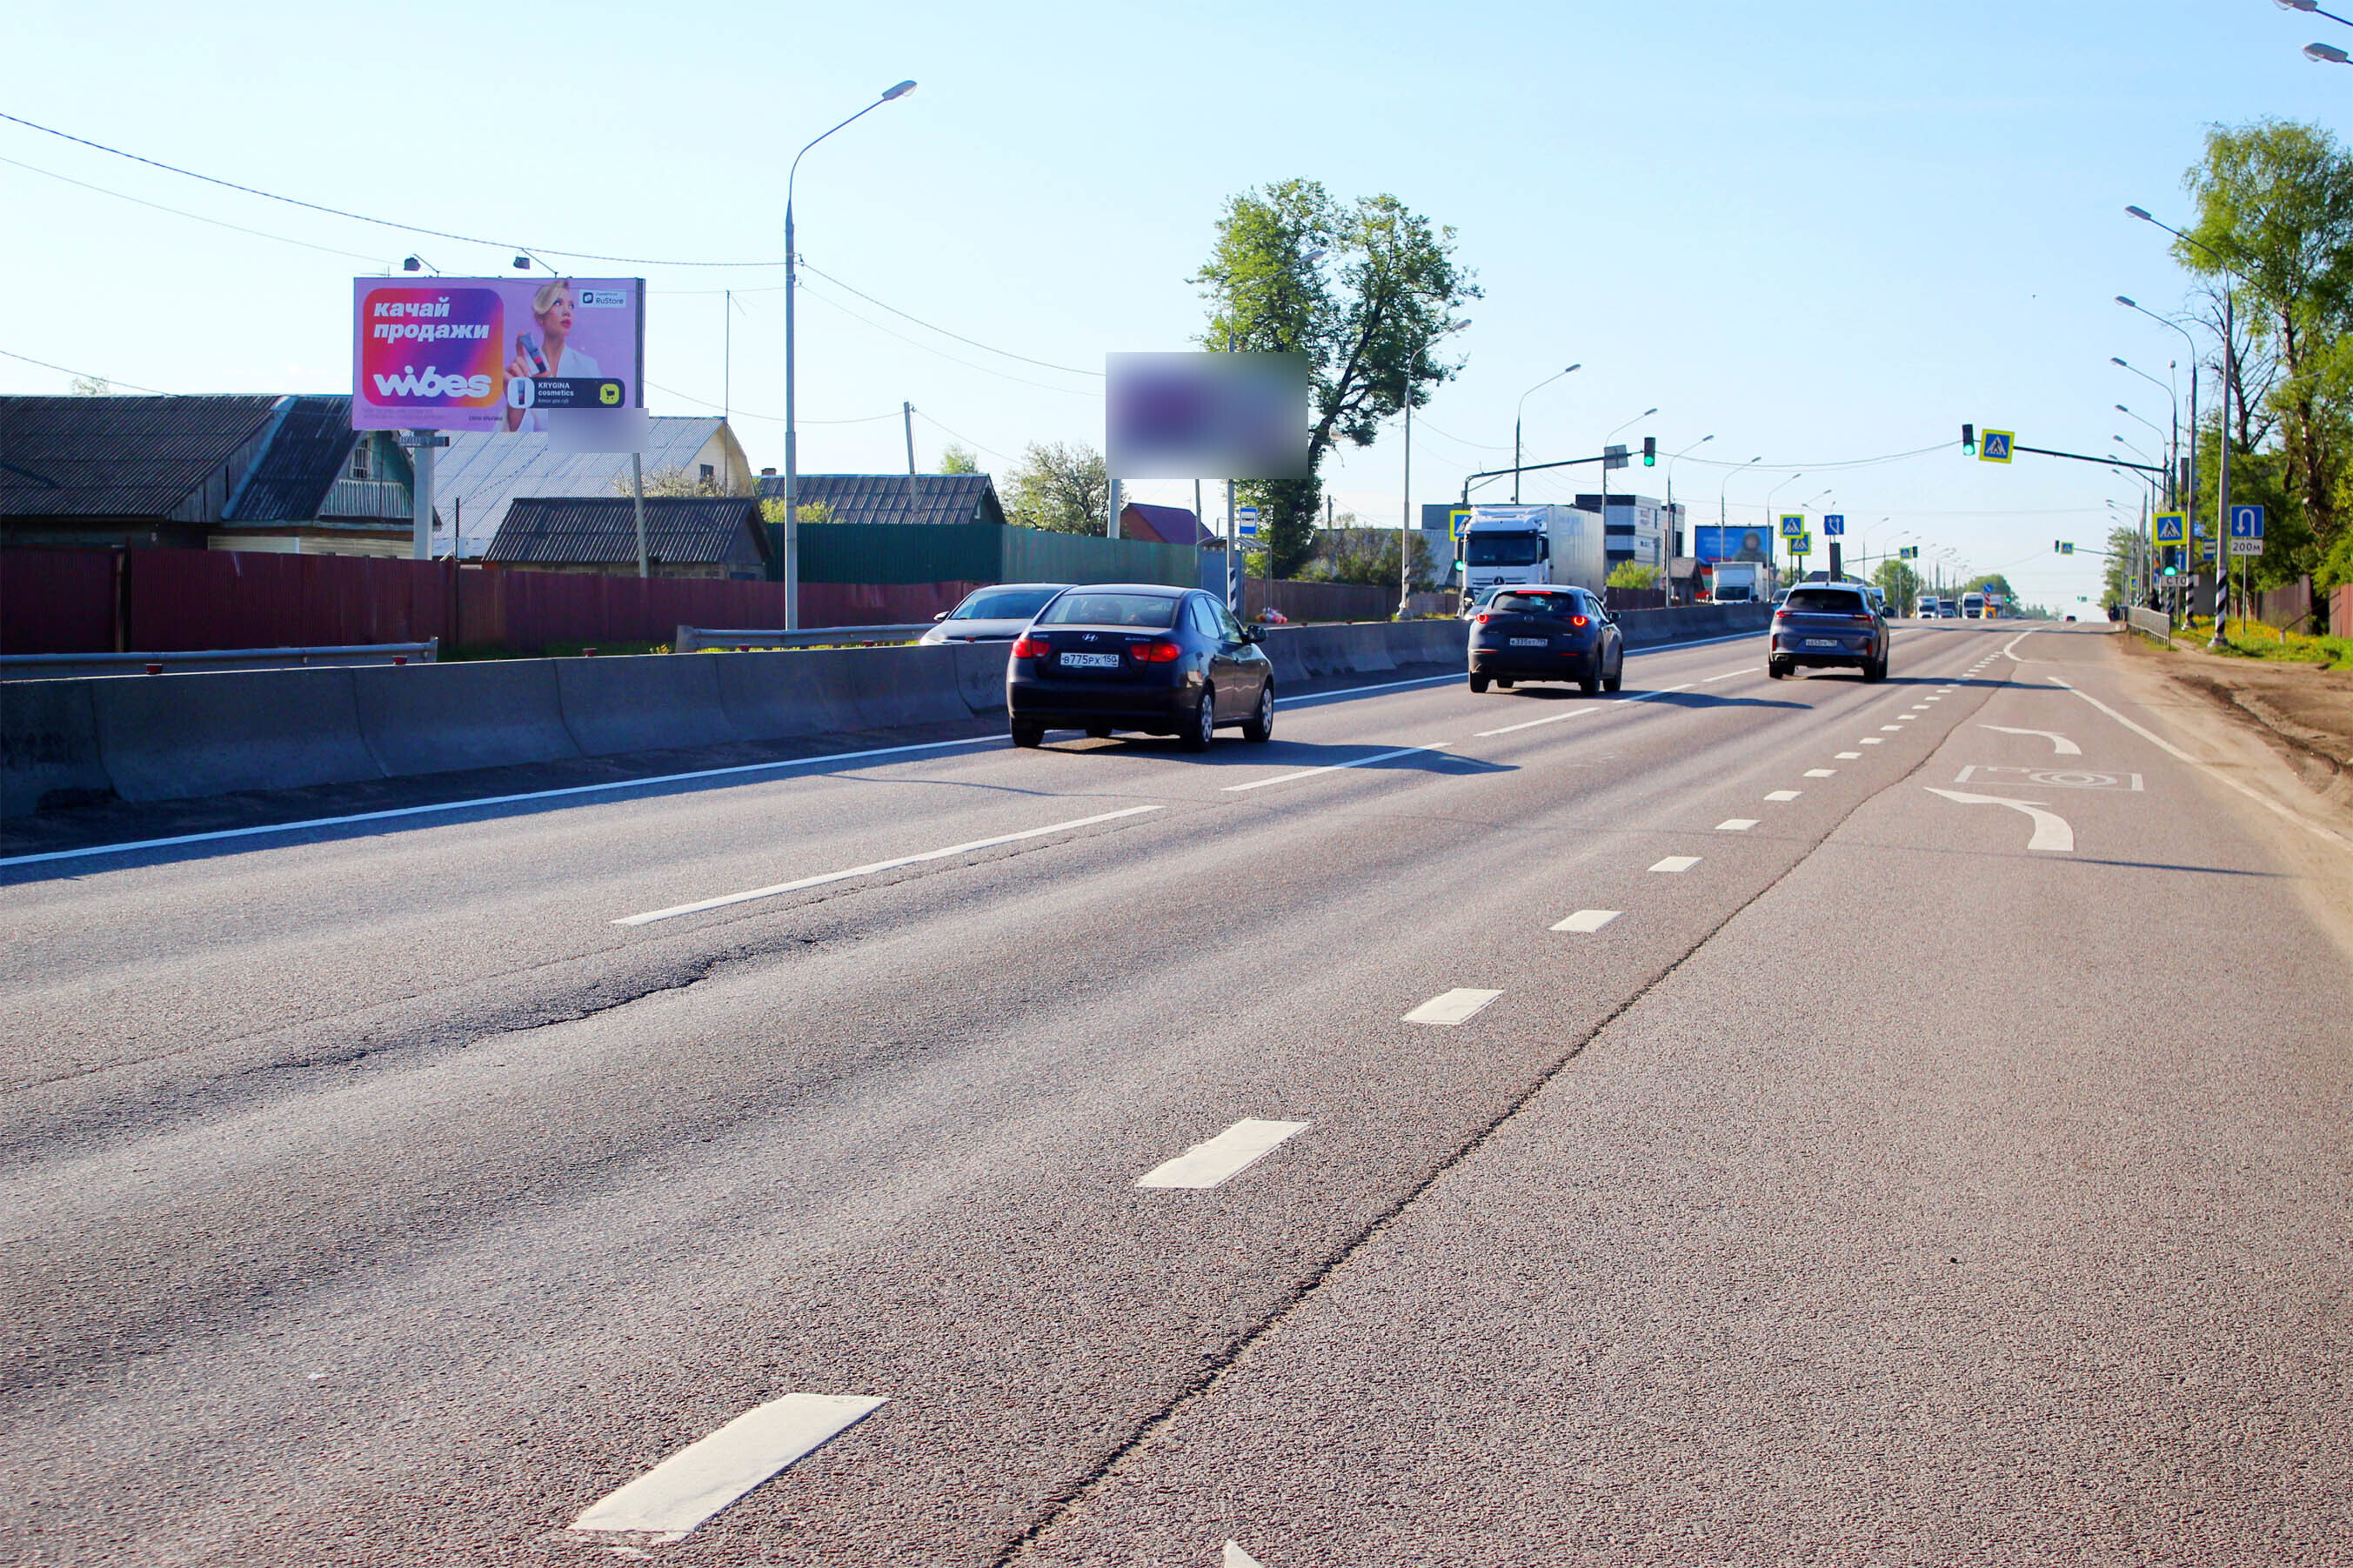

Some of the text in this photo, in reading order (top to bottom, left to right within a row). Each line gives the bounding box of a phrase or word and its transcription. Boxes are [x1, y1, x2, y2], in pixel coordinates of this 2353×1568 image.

[374, 297, 450, 317] качай
[374, 324, 490, 344] продажи
[373, 365, 492, 397] wibes
